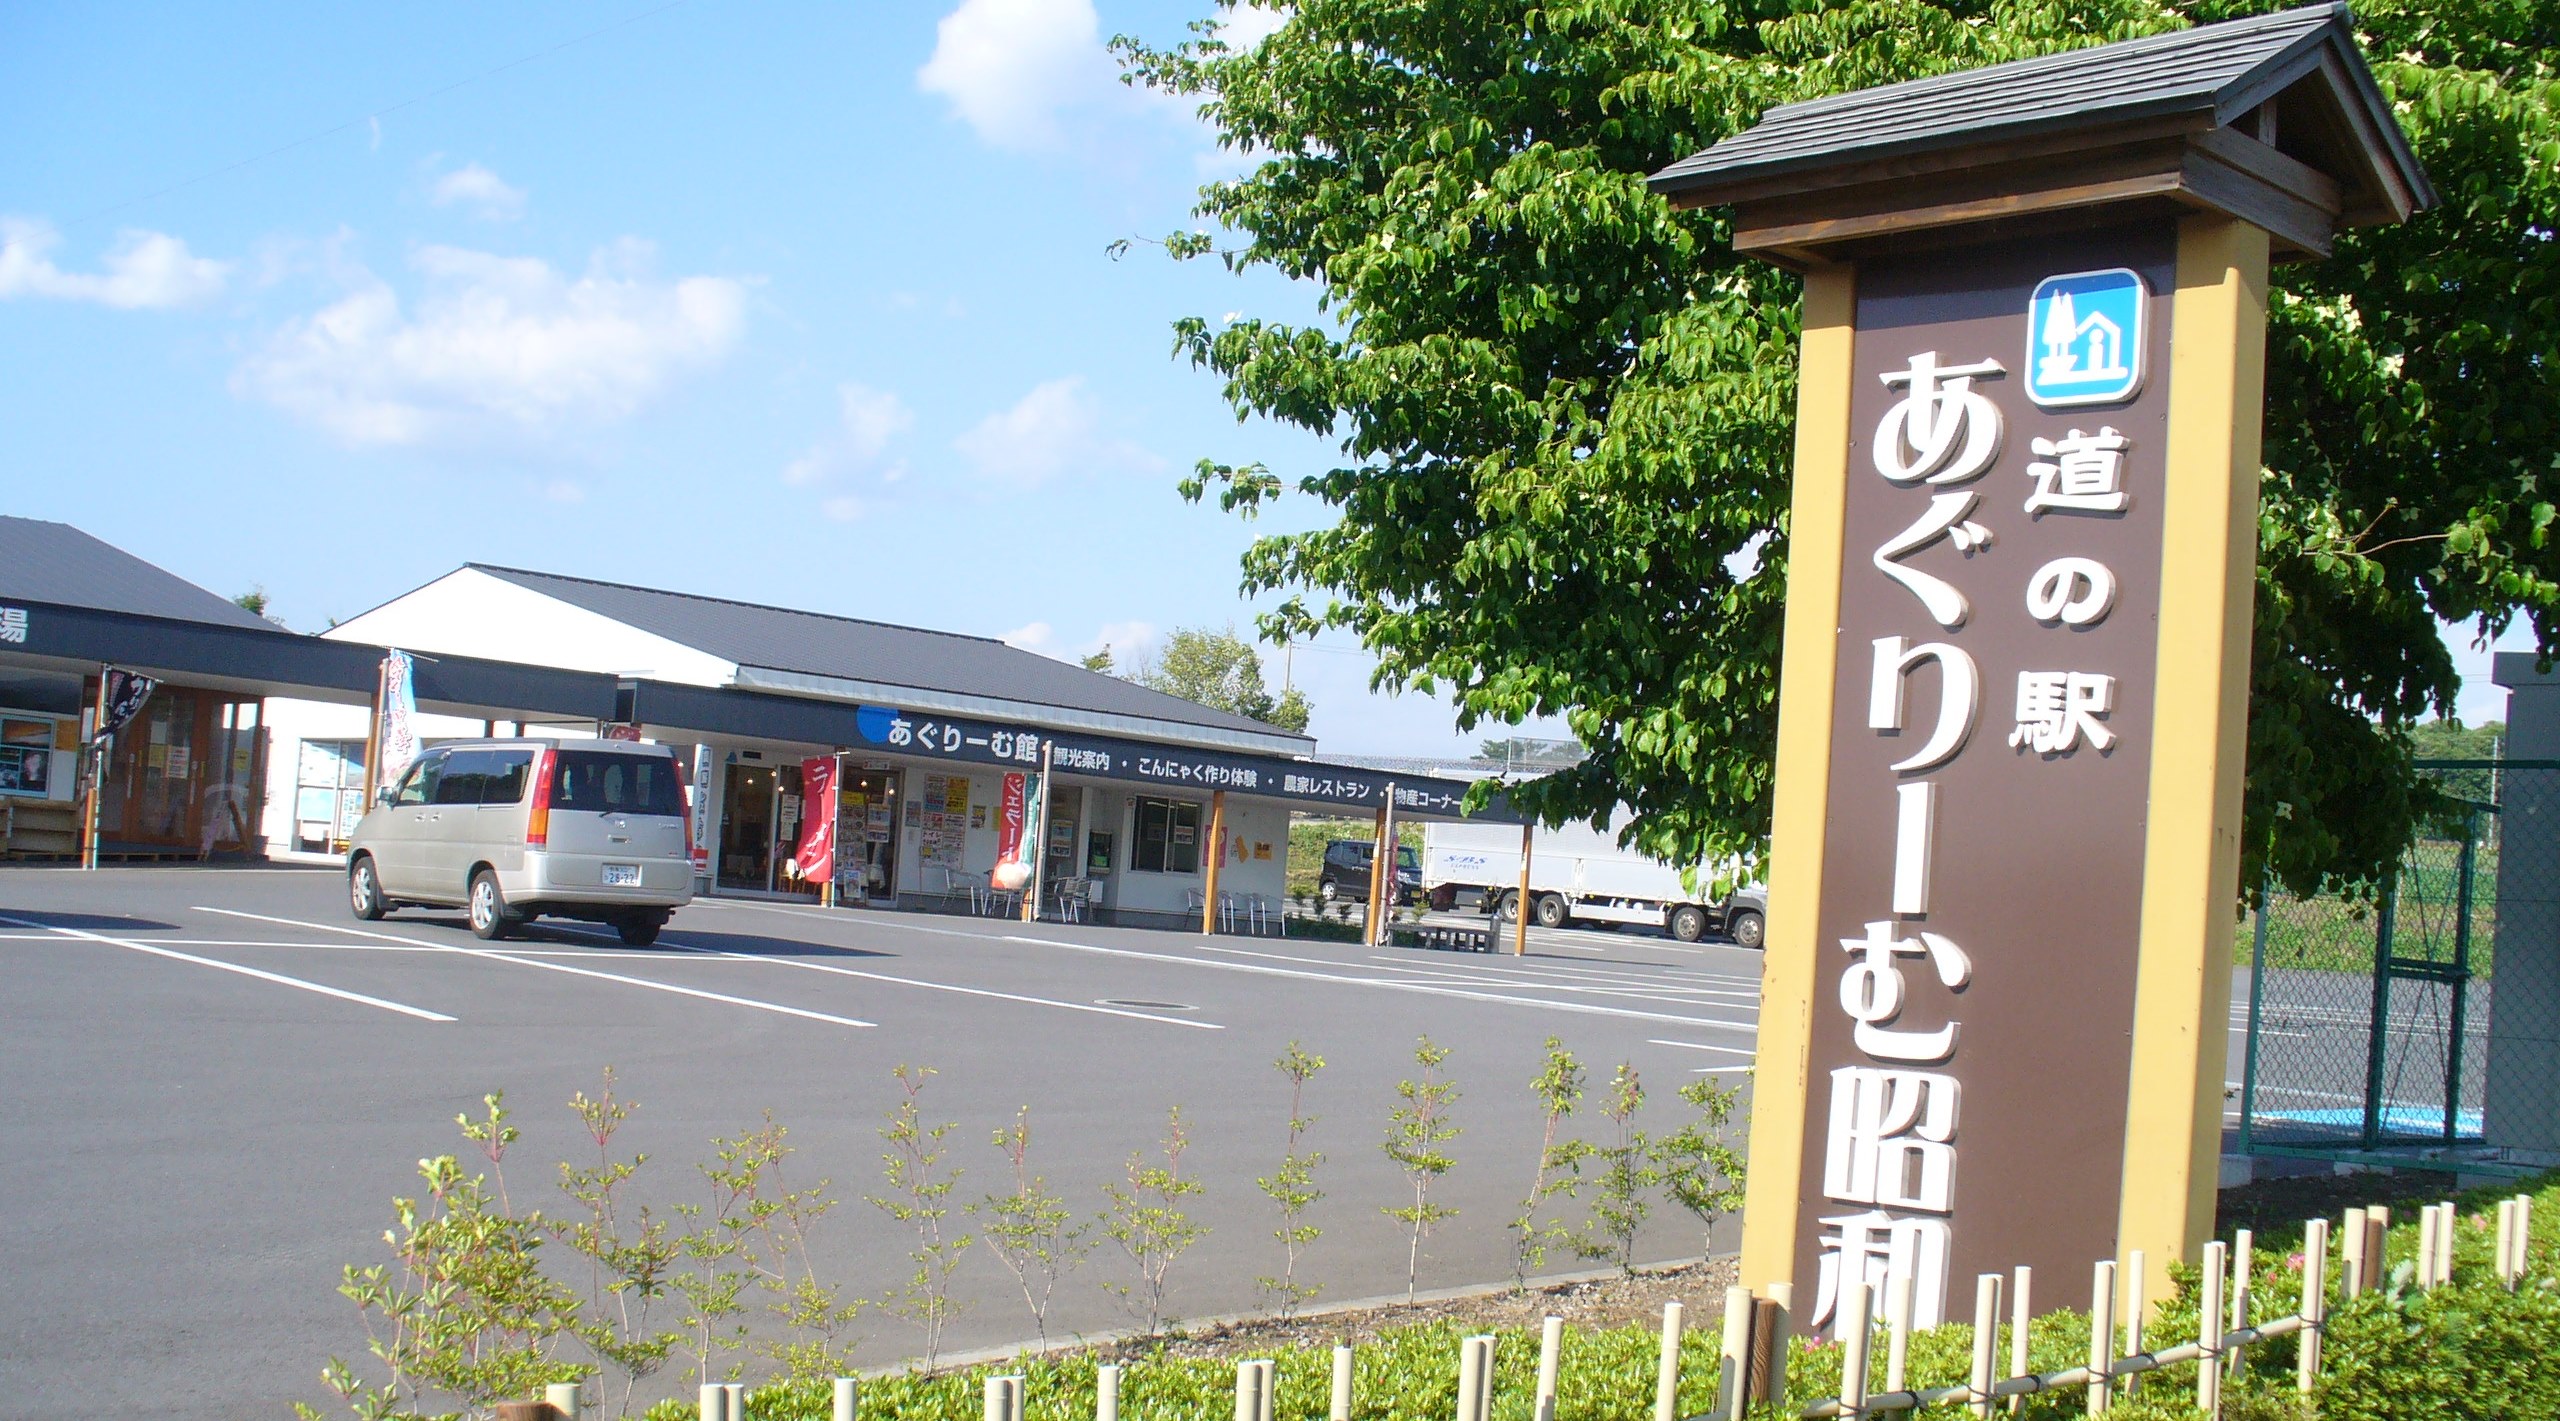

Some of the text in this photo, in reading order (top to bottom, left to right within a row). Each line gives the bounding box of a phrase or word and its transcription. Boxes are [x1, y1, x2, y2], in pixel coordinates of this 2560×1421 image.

[2009, 425, 2132, 753] 道の駅
[888, 718, 1039, 763] あぐりーむ館
[1053, 746, 1110, 771] 観光案内
[1138, 757, 1258, 788] こんにゃく作り体験
[1284, 775, 1370, 799] 農家レストラン
[805, 765, 829, 876] ラメン
[1811, 350, 2008, 1343] あぐりーむ昭和
